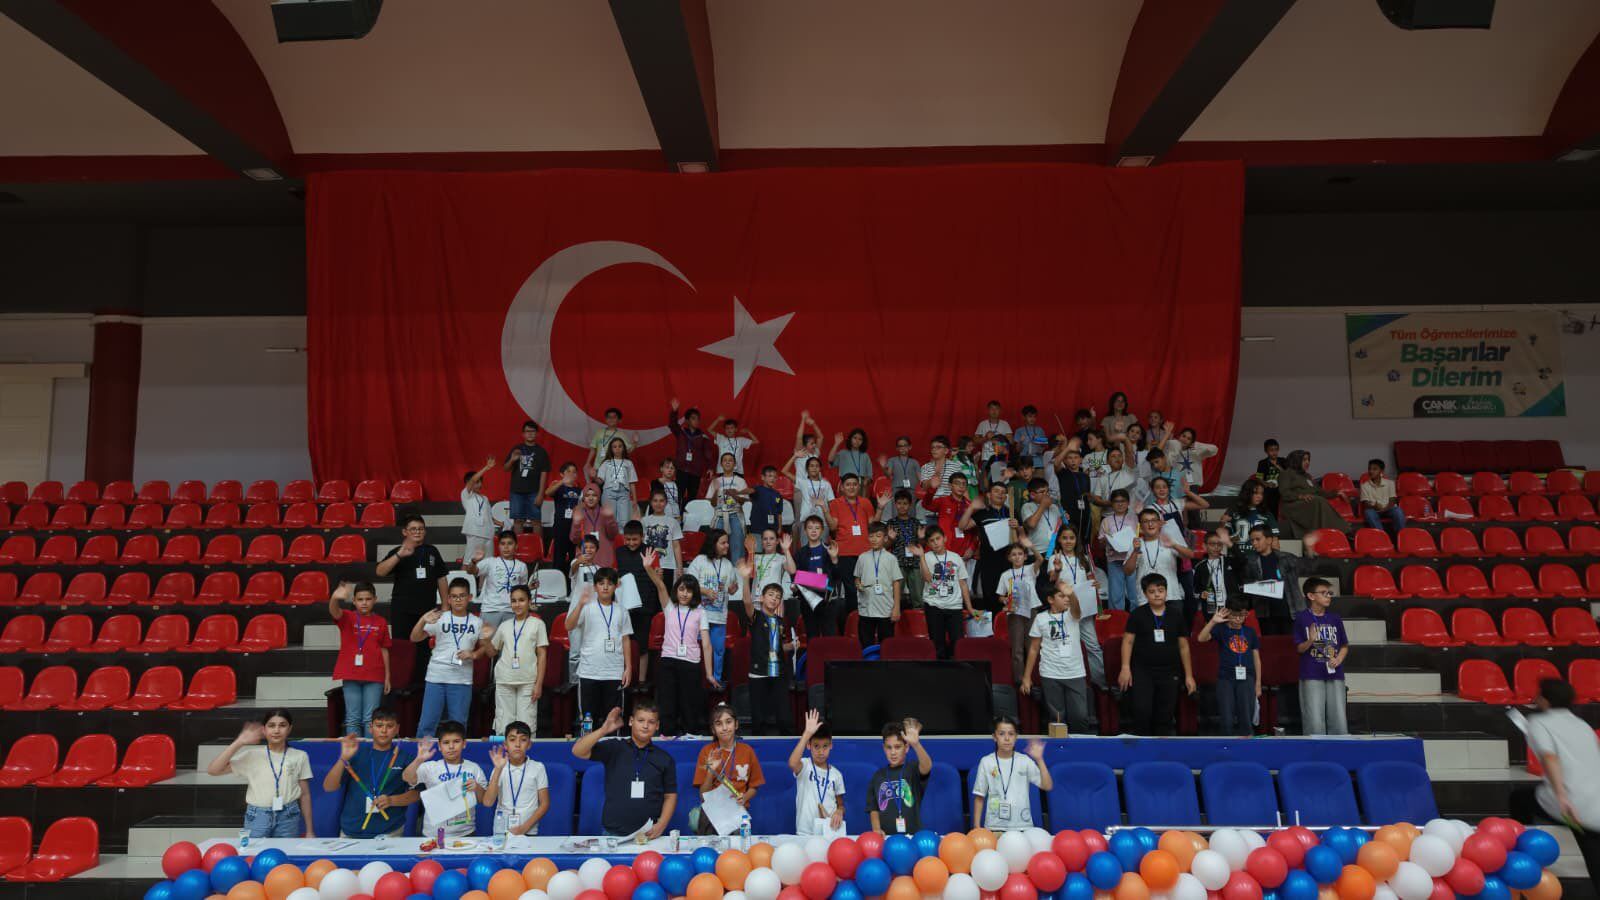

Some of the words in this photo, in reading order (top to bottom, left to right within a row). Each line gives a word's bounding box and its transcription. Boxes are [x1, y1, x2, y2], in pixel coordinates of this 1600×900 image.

[1391, 329, 1416, 340] Tüm
[1420, 328, 1518, 341] Öğrencilerimize
[1400, 341, 1510, 366] Başarılar
[1411, 366, 1502, 387] Dilerim
[442, 623, 475, 634] USPA
[1305, 625, 1338, 646] LKERS
